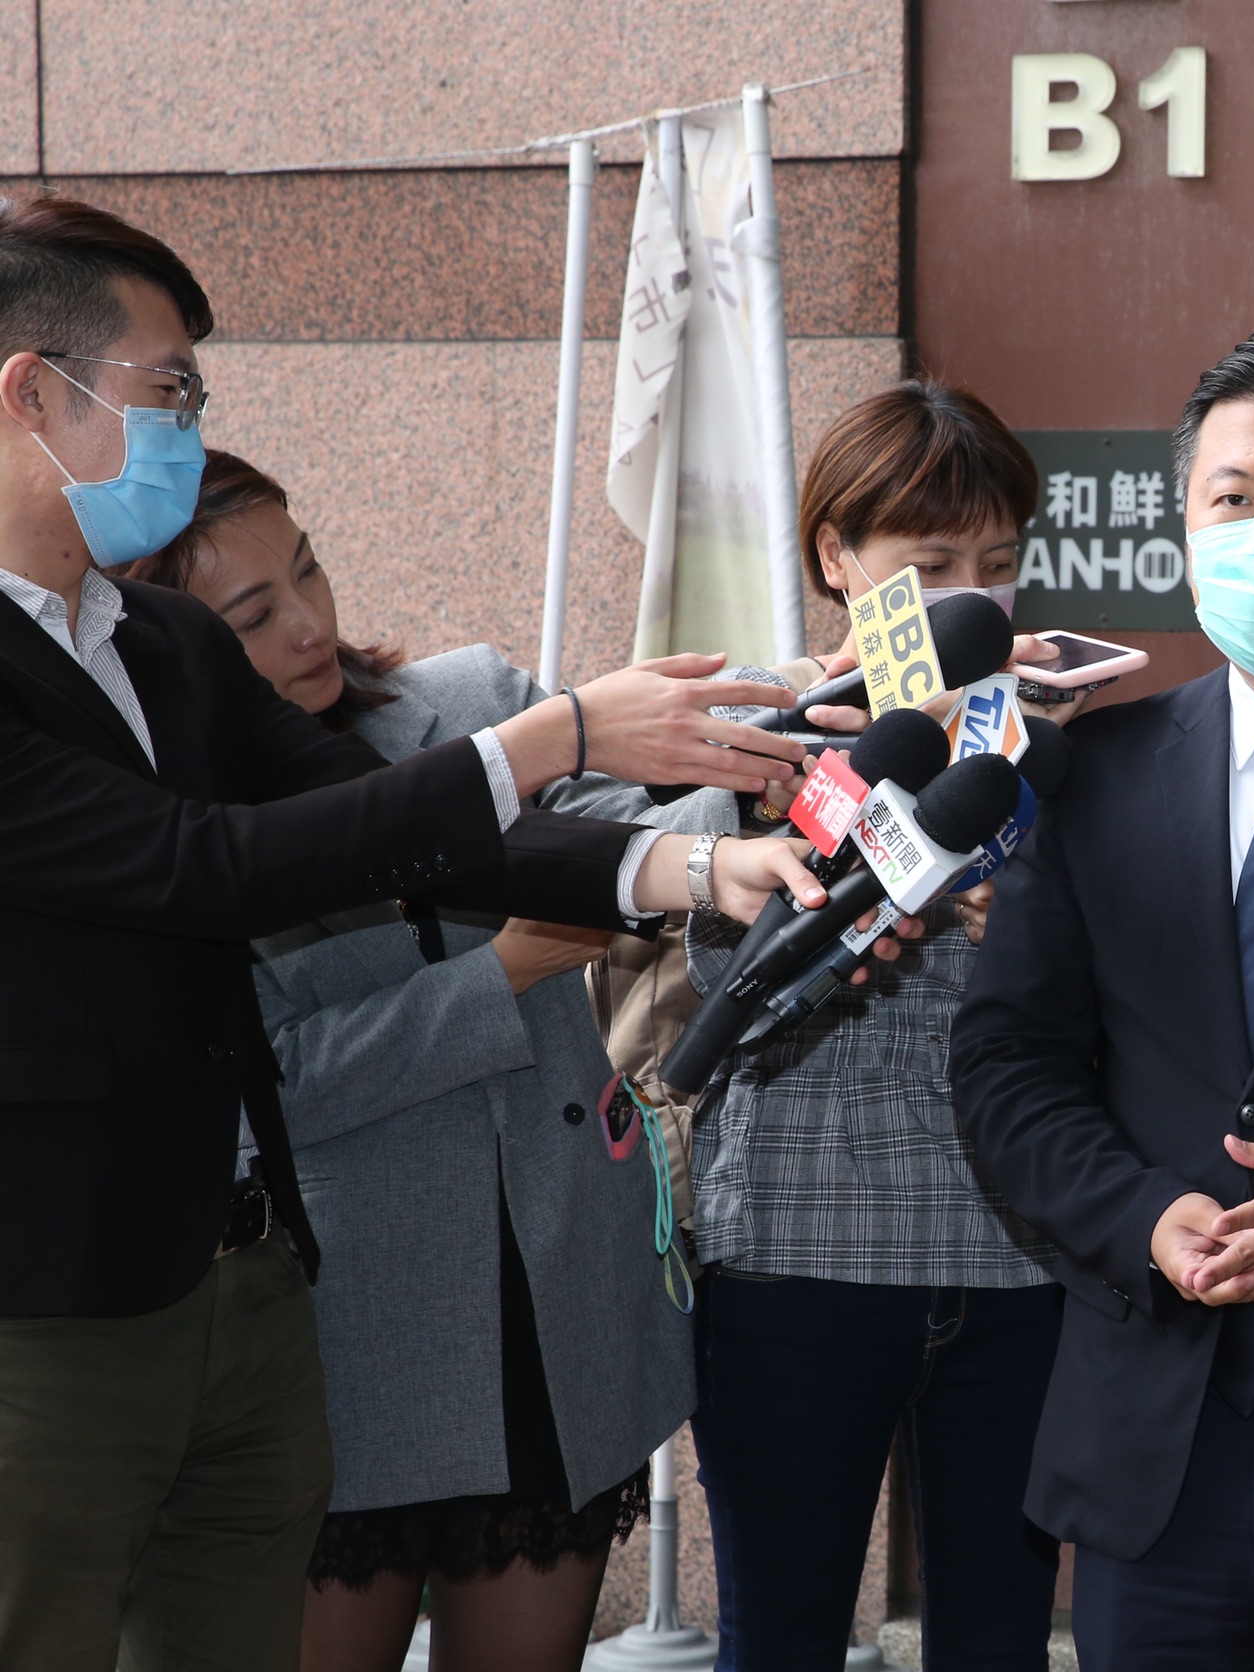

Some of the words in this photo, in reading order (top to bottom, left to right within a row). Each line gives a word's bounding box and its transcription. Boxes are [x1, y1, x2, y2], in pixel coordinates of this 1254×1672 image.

[1011, 46, 1207, 182] B1
[1027, 470, 1186, 530] 和鮮
[1017, 537, 1190, 593] ANHO
[801, 765, 860, 841] 年代新聞
[868, 799, 923, 875] 壹新聞
[736, 978, 759, 998] SONY
